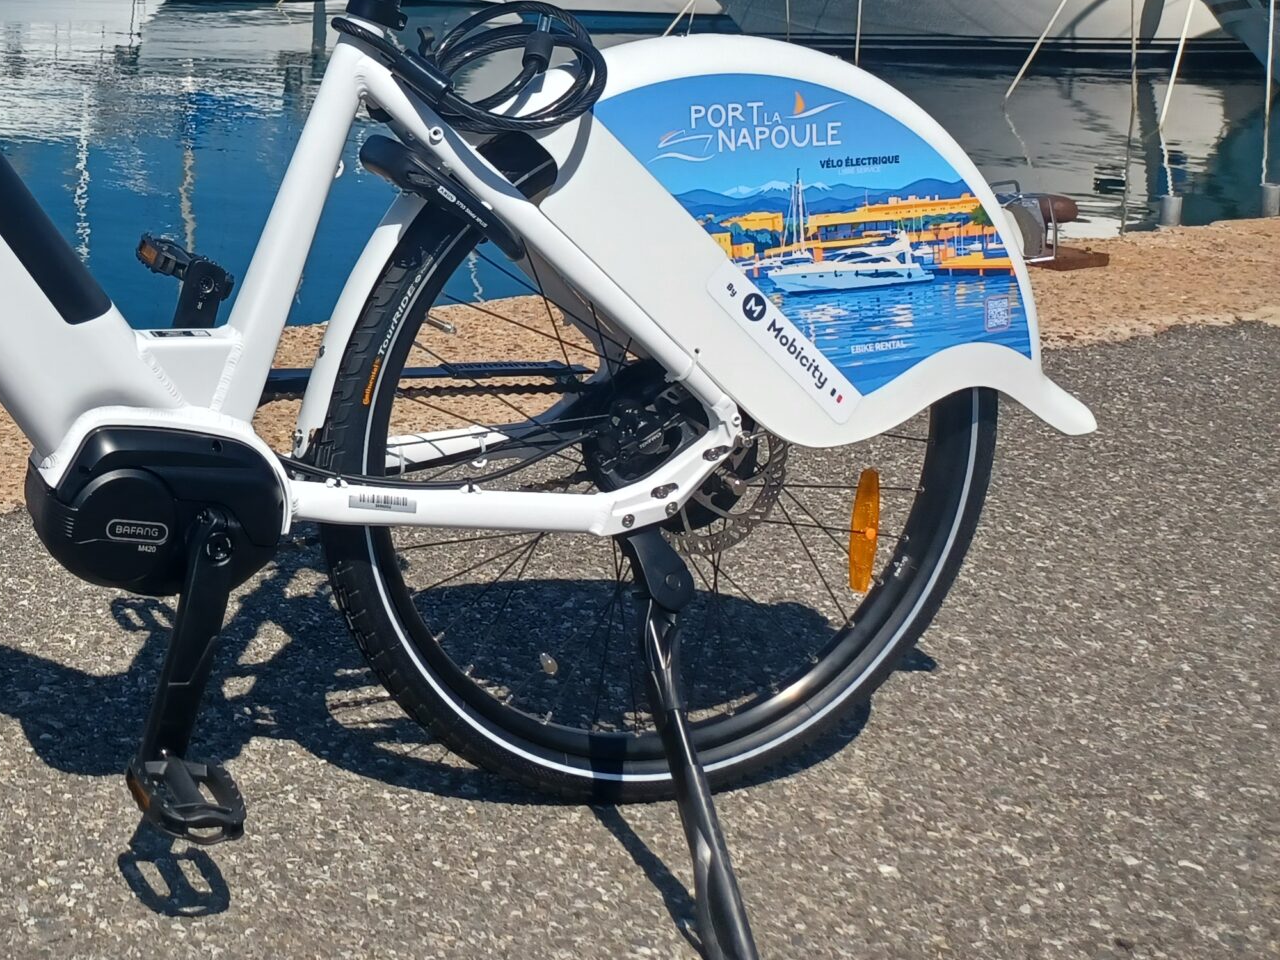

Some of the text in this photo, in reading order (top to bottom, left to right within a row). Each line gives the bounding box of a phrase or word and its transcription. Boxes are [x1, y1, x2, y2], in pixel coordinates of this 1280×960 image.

[690, 101, 782, 129] PORT LA
[718, 122, 842, 153] NAPOULE
[819, 155, 900, 168] VÉLO ÉLECTRIQUE
[726, 283, 737, 298] By
[745, 296, 764, 319] M
[767, 318, 828, 390] Mobicity
[874, 339, 905, 352] RENTAL
[115, 524, 159, 537] BAFANG
